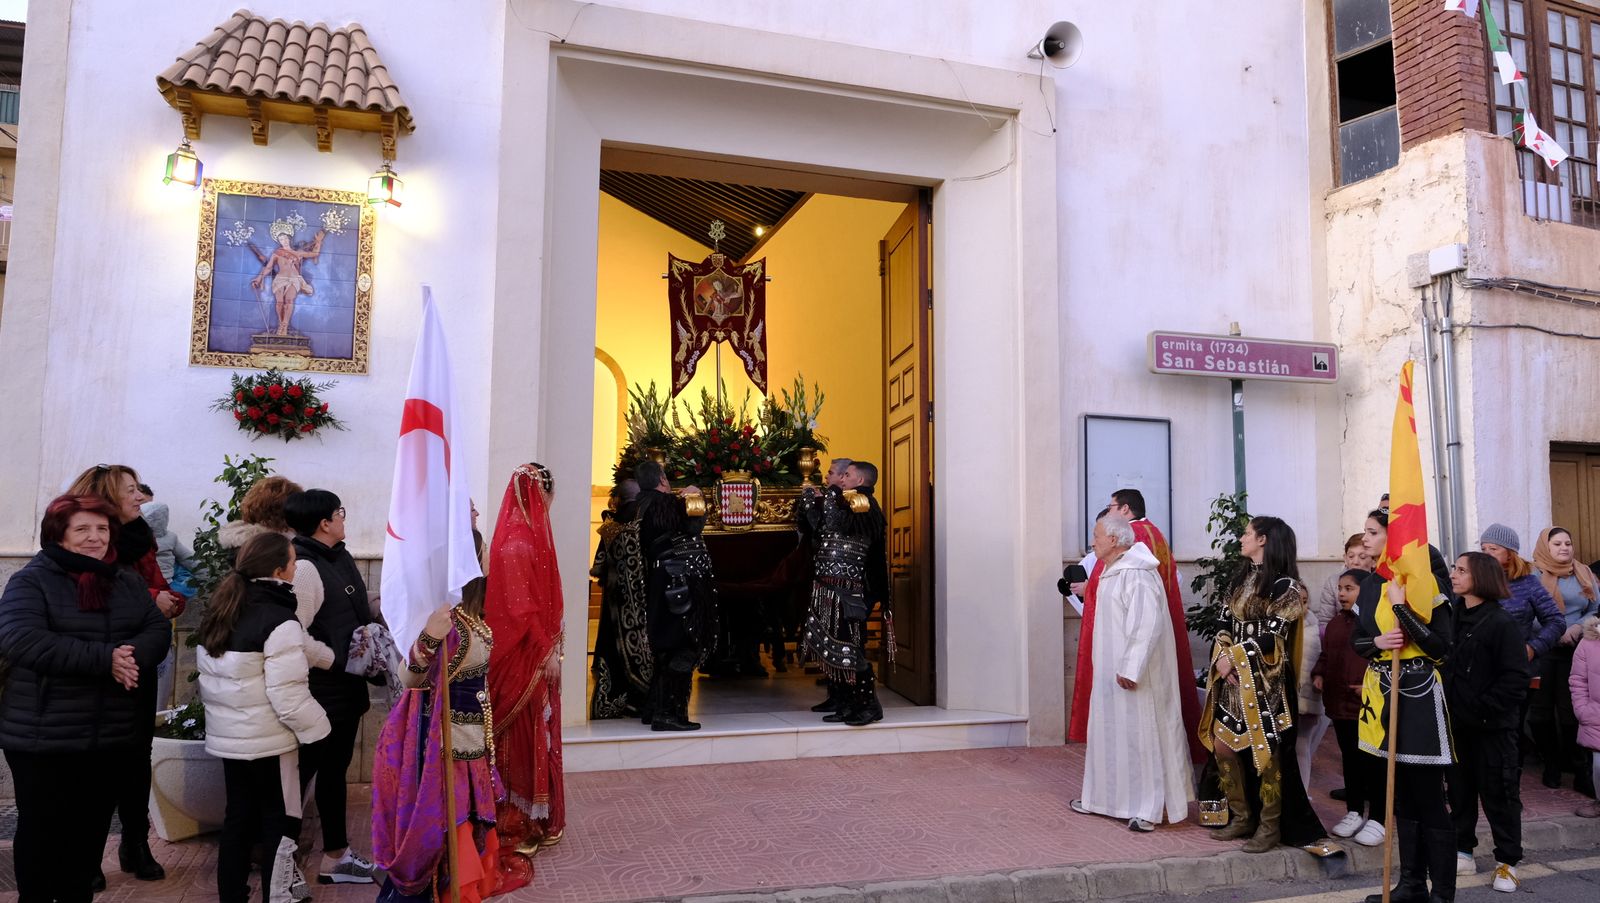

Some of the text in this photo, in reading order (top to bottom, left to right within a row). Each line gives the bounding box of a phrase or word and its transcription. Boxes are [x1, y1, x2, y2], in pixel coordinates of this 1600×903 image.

[1162, 340, 1249, 356] ermita (1734)
[1162, 352, 1290, 375] San Sebastián
